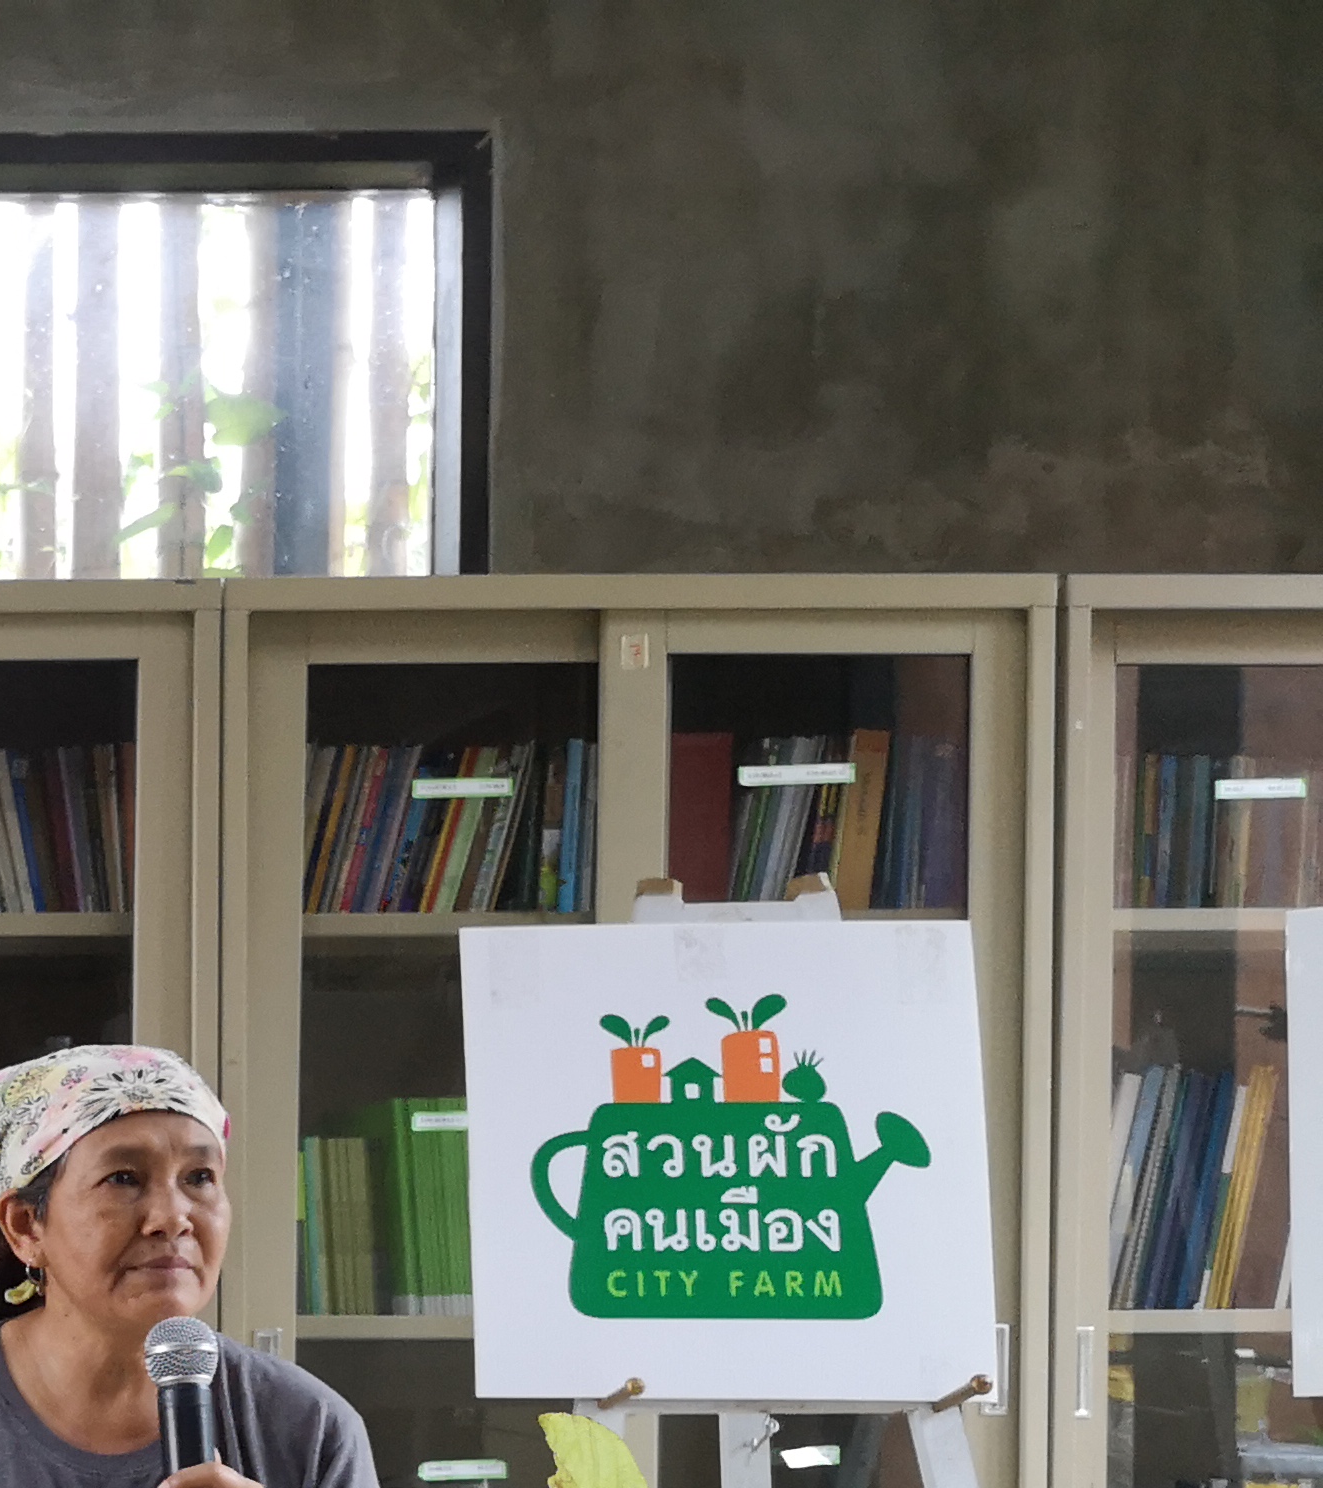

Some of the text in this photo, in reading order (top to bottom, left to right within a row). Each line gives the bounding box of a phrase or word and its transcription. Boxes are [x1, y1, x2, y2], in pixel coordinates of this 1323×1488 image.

[602, 1113, 838, 1178] สวนผัก
[603, 1186, 841, 1252] คนเมือง
[606, 1270, 843, 1298] CITY FARM
